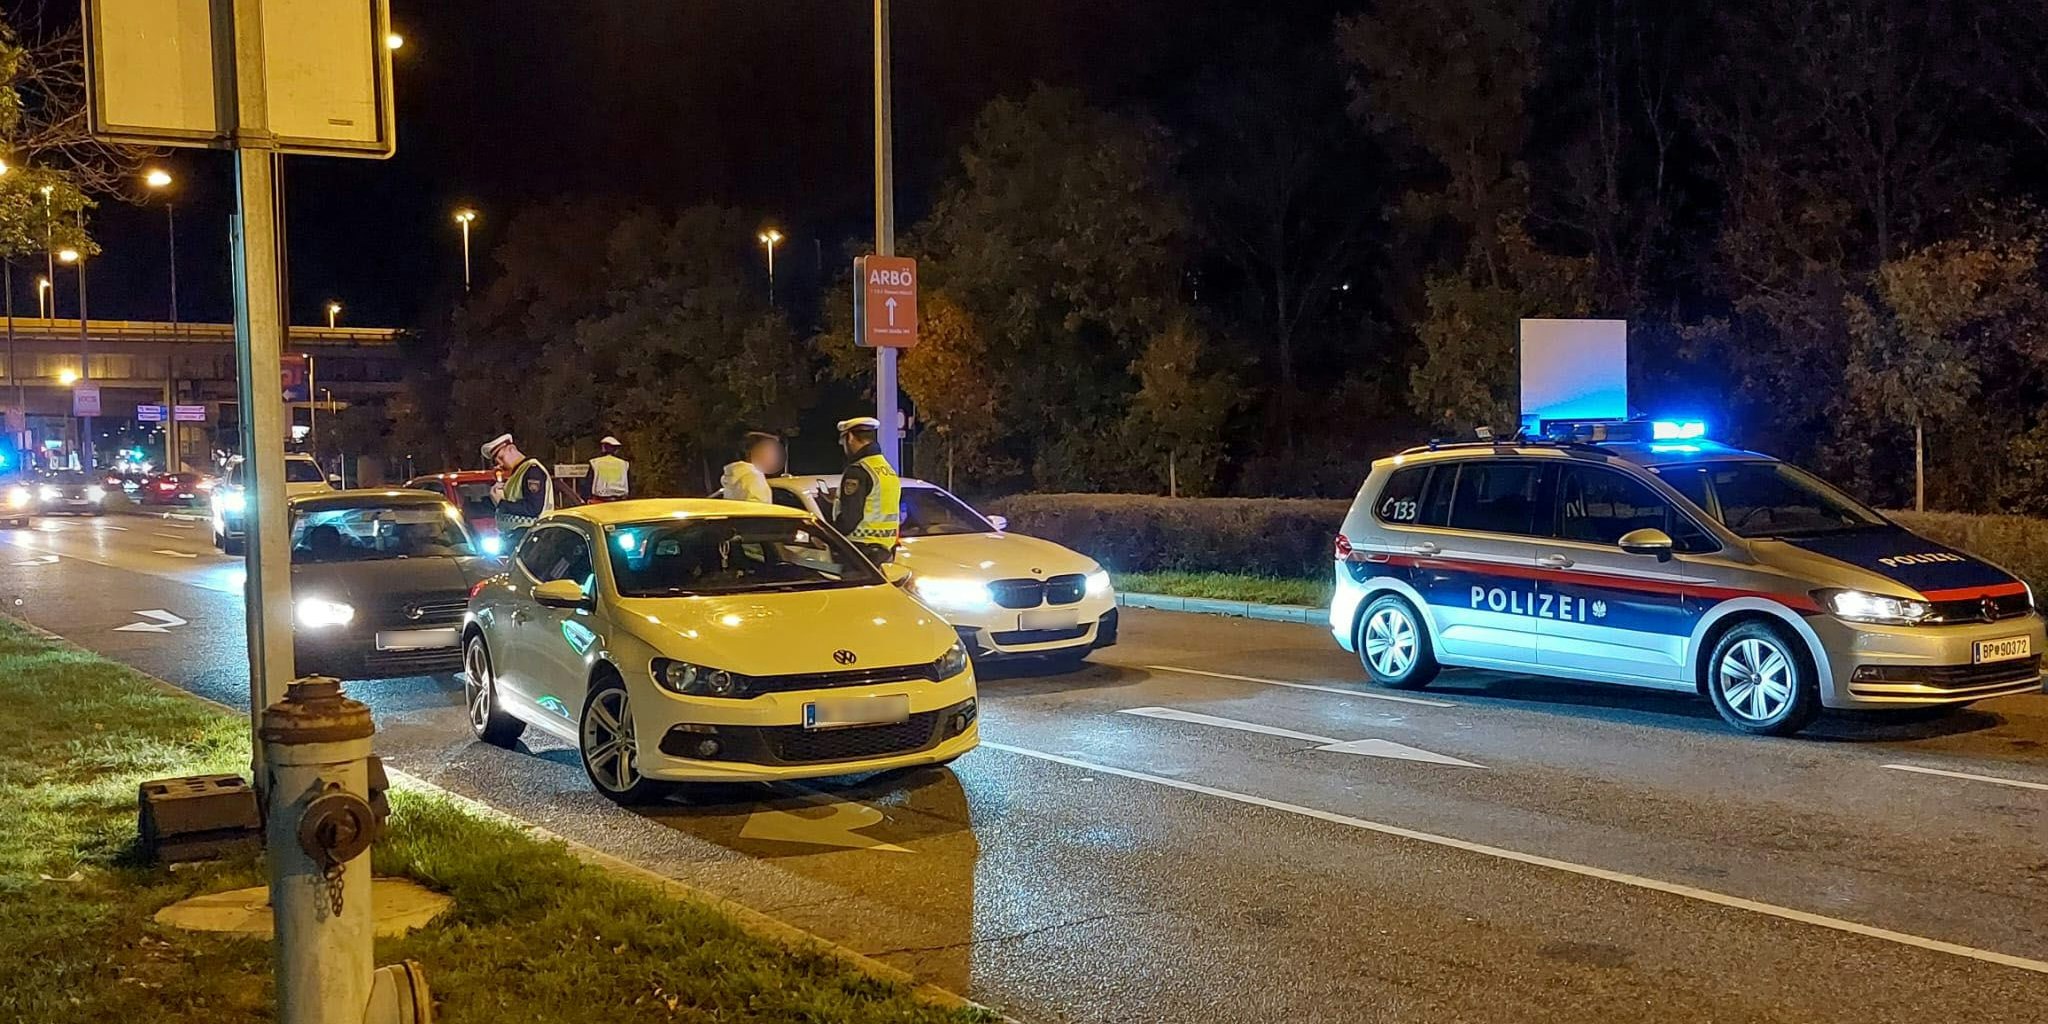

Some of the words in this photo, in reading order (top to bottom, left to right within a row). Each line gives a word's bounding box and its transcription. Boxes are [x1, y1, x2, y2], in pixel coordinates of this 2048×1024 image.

[869, 267, 912, 287] ARBÖ
[1393, 501, 1417, 520] 133
[1877, 552, 1967, 567] POLIZEI
[1471, 586, 1586, 622] POLIZEI
